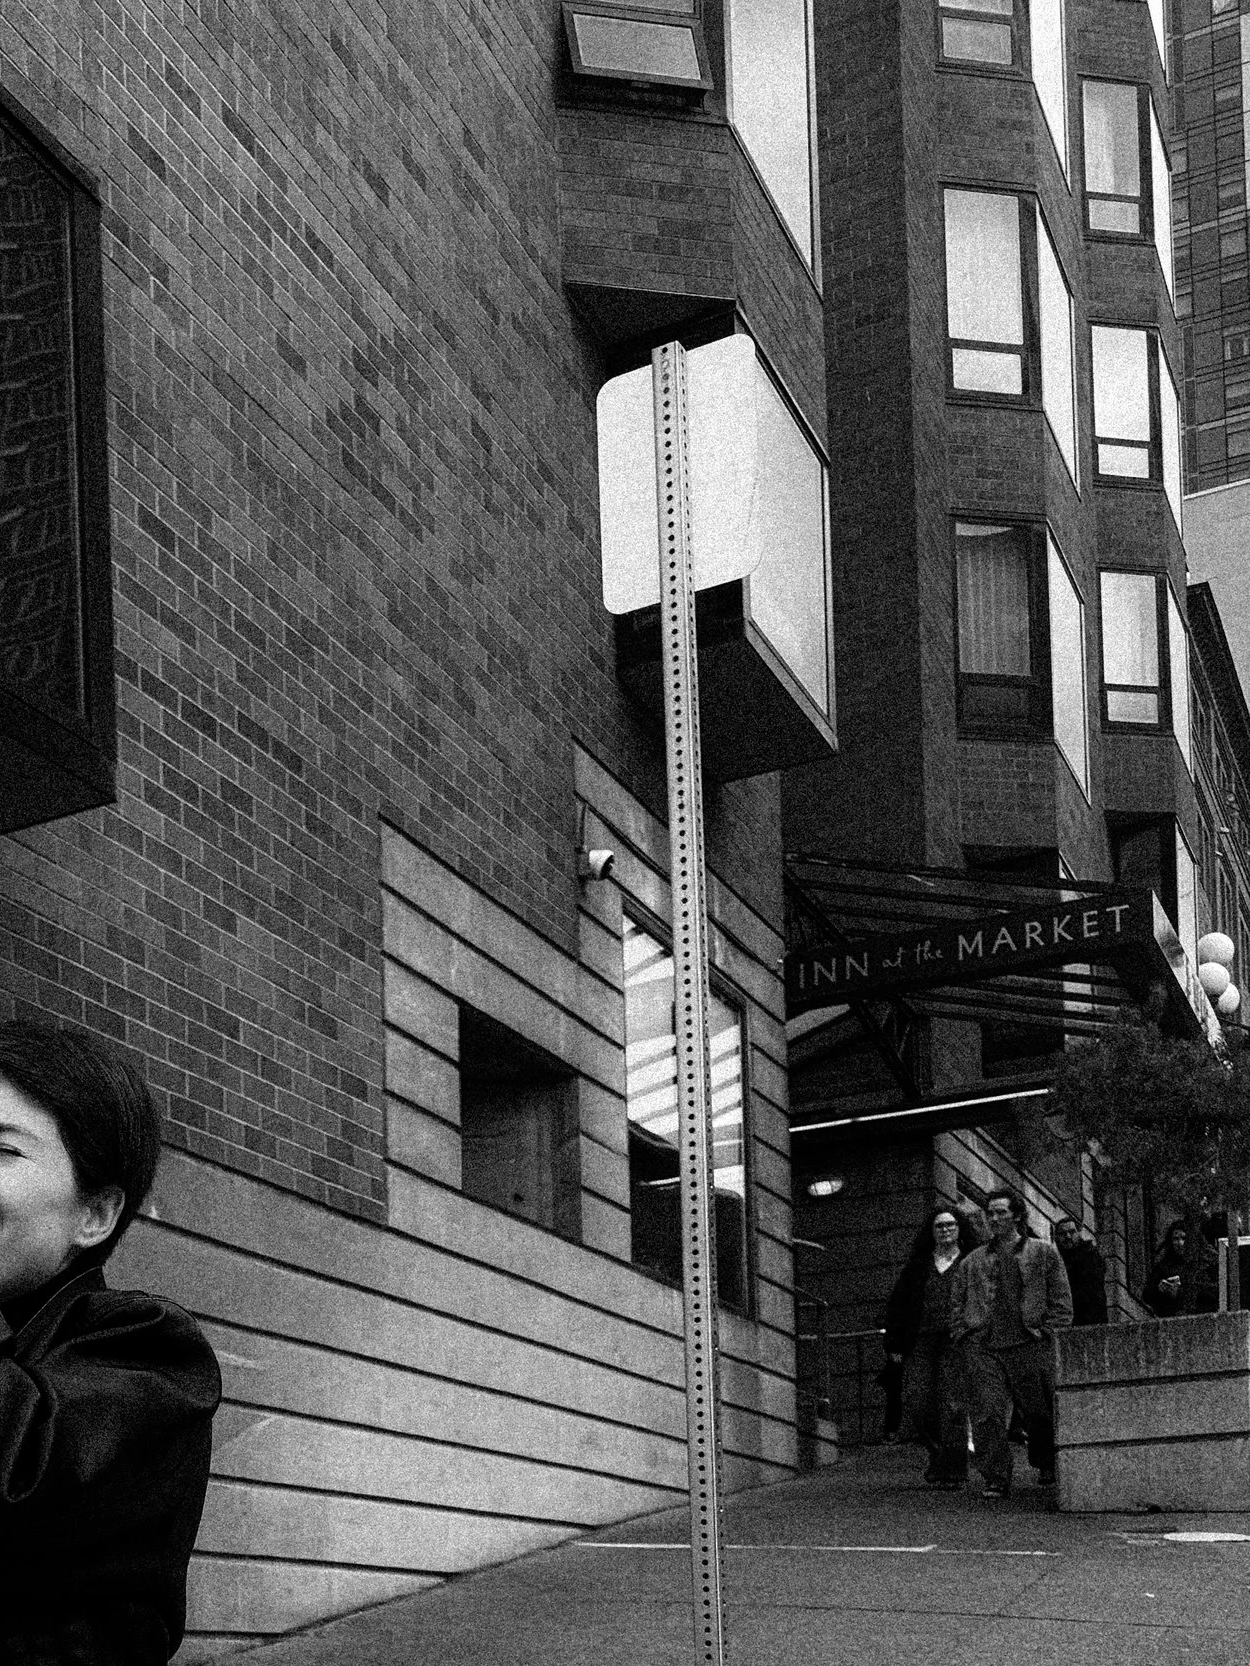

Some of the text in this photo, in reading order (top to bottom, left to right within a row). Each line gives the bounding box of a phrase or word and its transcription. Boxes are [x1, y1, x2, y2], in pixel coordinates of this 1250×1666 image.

[799, 904, 1131, 990] INN at the MARKET
